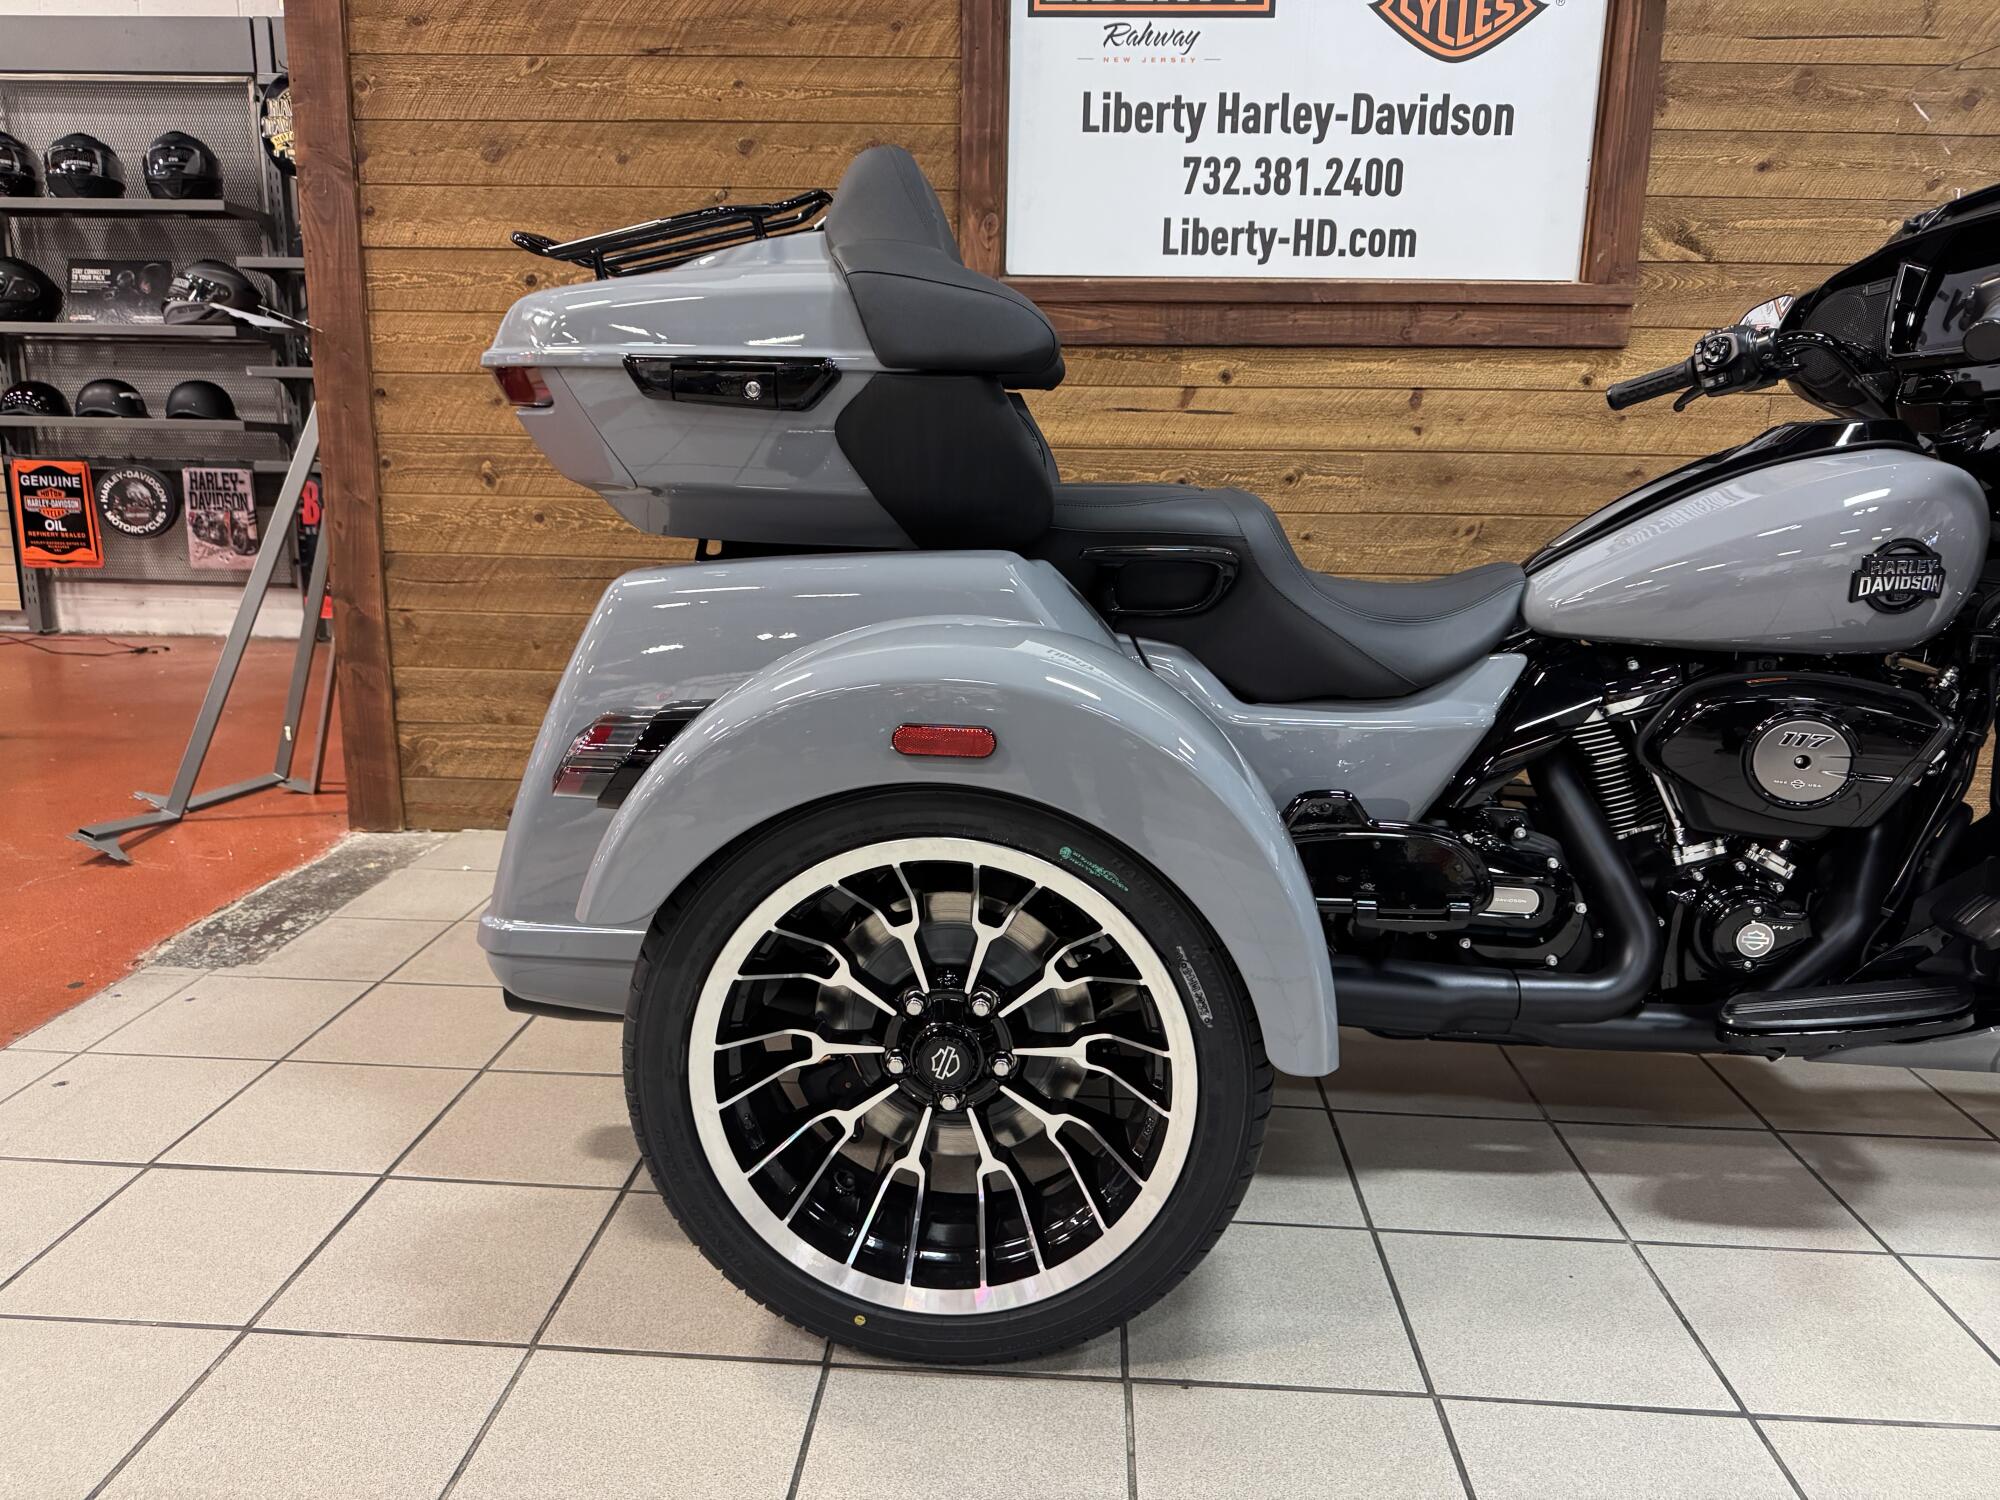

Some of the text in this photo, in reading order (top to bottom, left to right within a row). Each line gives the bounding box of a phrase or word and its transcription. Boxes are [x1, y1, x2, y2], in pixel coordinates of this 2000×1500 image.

[1103, 21, 1200, 55] Rahway
[1082, 91, 1515, 144] Liberty Harley-Davidson
[1183, 156, 1404, 198] 732.381.2400
[1162, 217, 1417, 265] Liberty-HD.com
[20, 474, 81, 488] GENUINE
[100, 470, 168, 503] HARLEY-DAVIDSON
[189, 471, 245, 491] HARLEY-
[189, 491, 250, 511] DAVIDSON
[44, 519, 67, 531] OIL
[104, 510, 167, 534] MOTORCYCLES
[1871, 560, 1940, 575] HARLEY-
[1858, 575, 1943, 597] DAVIDSON
[1779, 731, 1835, 749] 117
